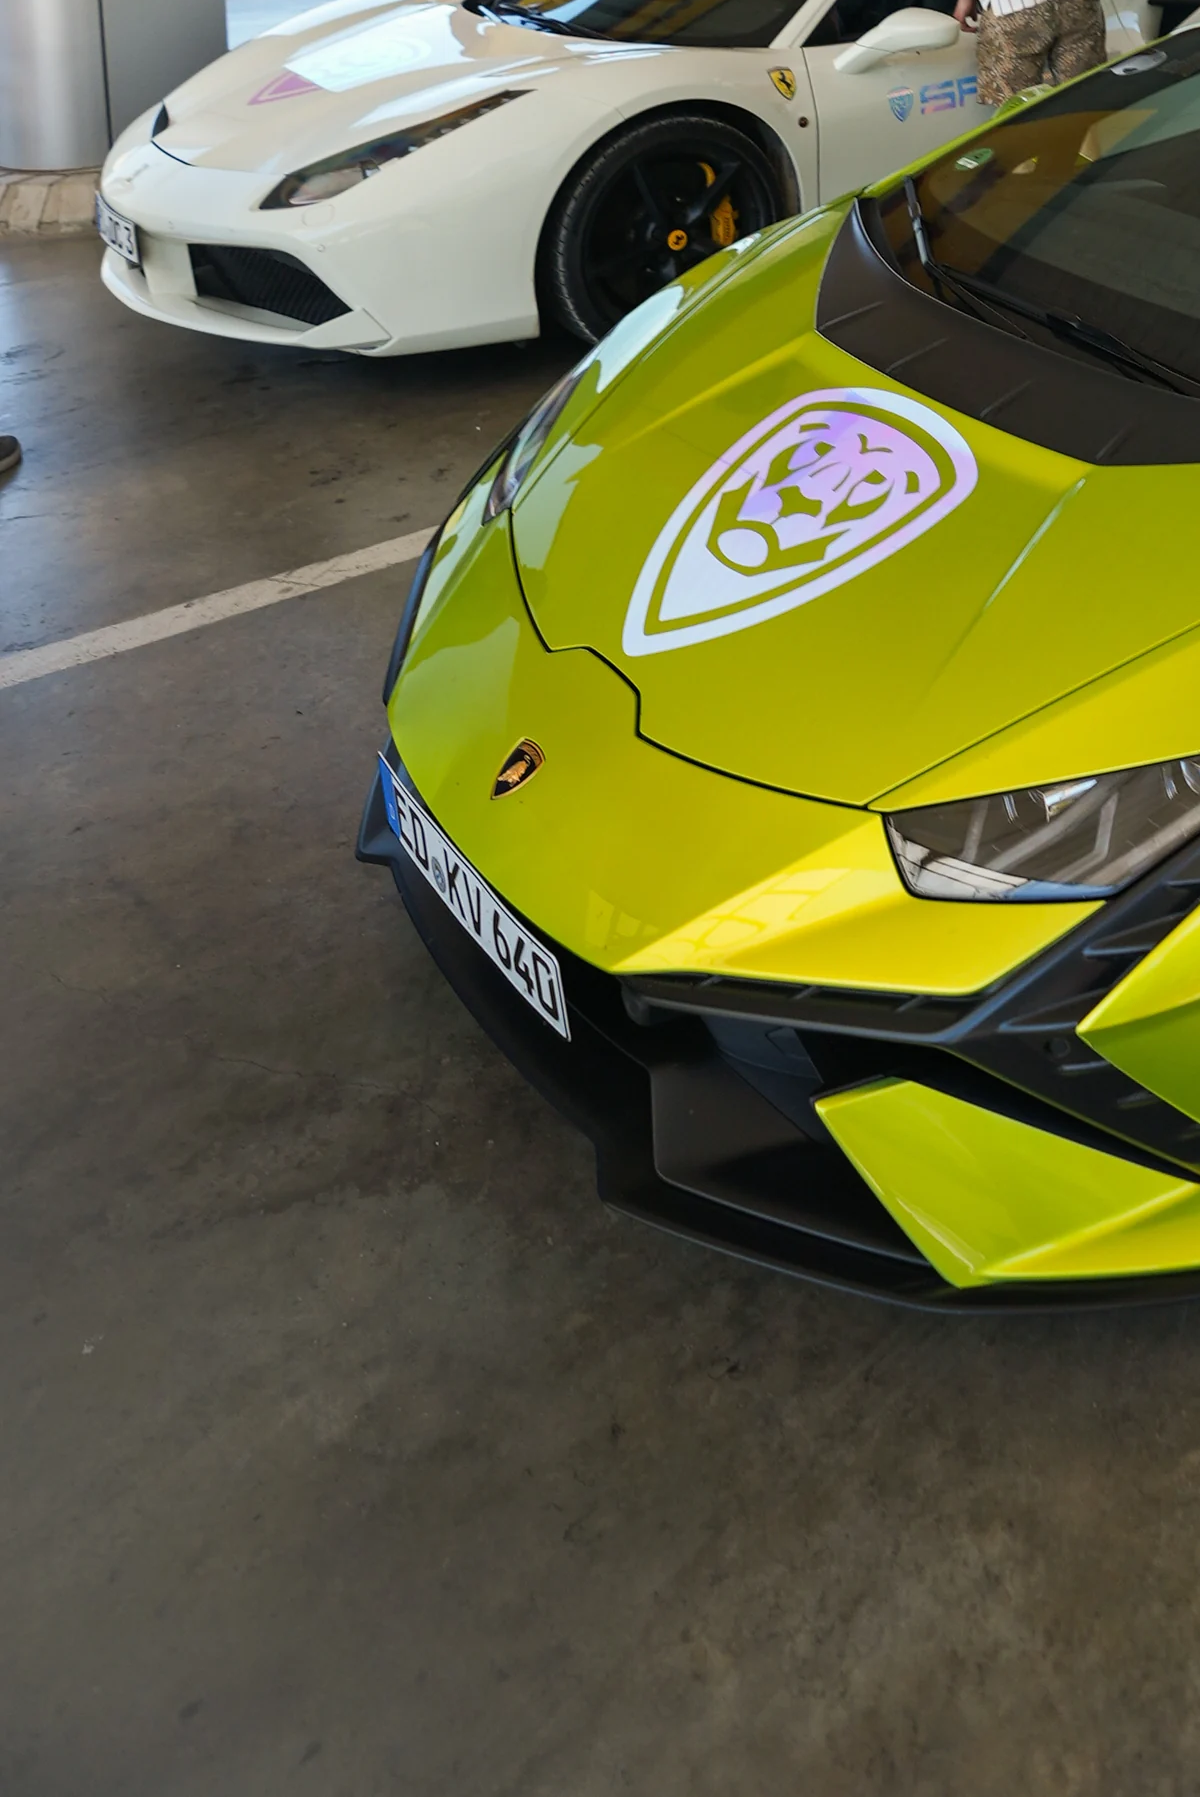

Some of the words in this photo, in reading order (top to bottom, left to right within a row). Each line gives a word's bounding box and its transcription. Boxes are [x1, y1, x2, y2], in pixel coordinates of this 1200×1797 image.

[393, 779, 429, 872] ED
[443, 847, 482, 937] KV
[493, 906, 560, 1022] 640
